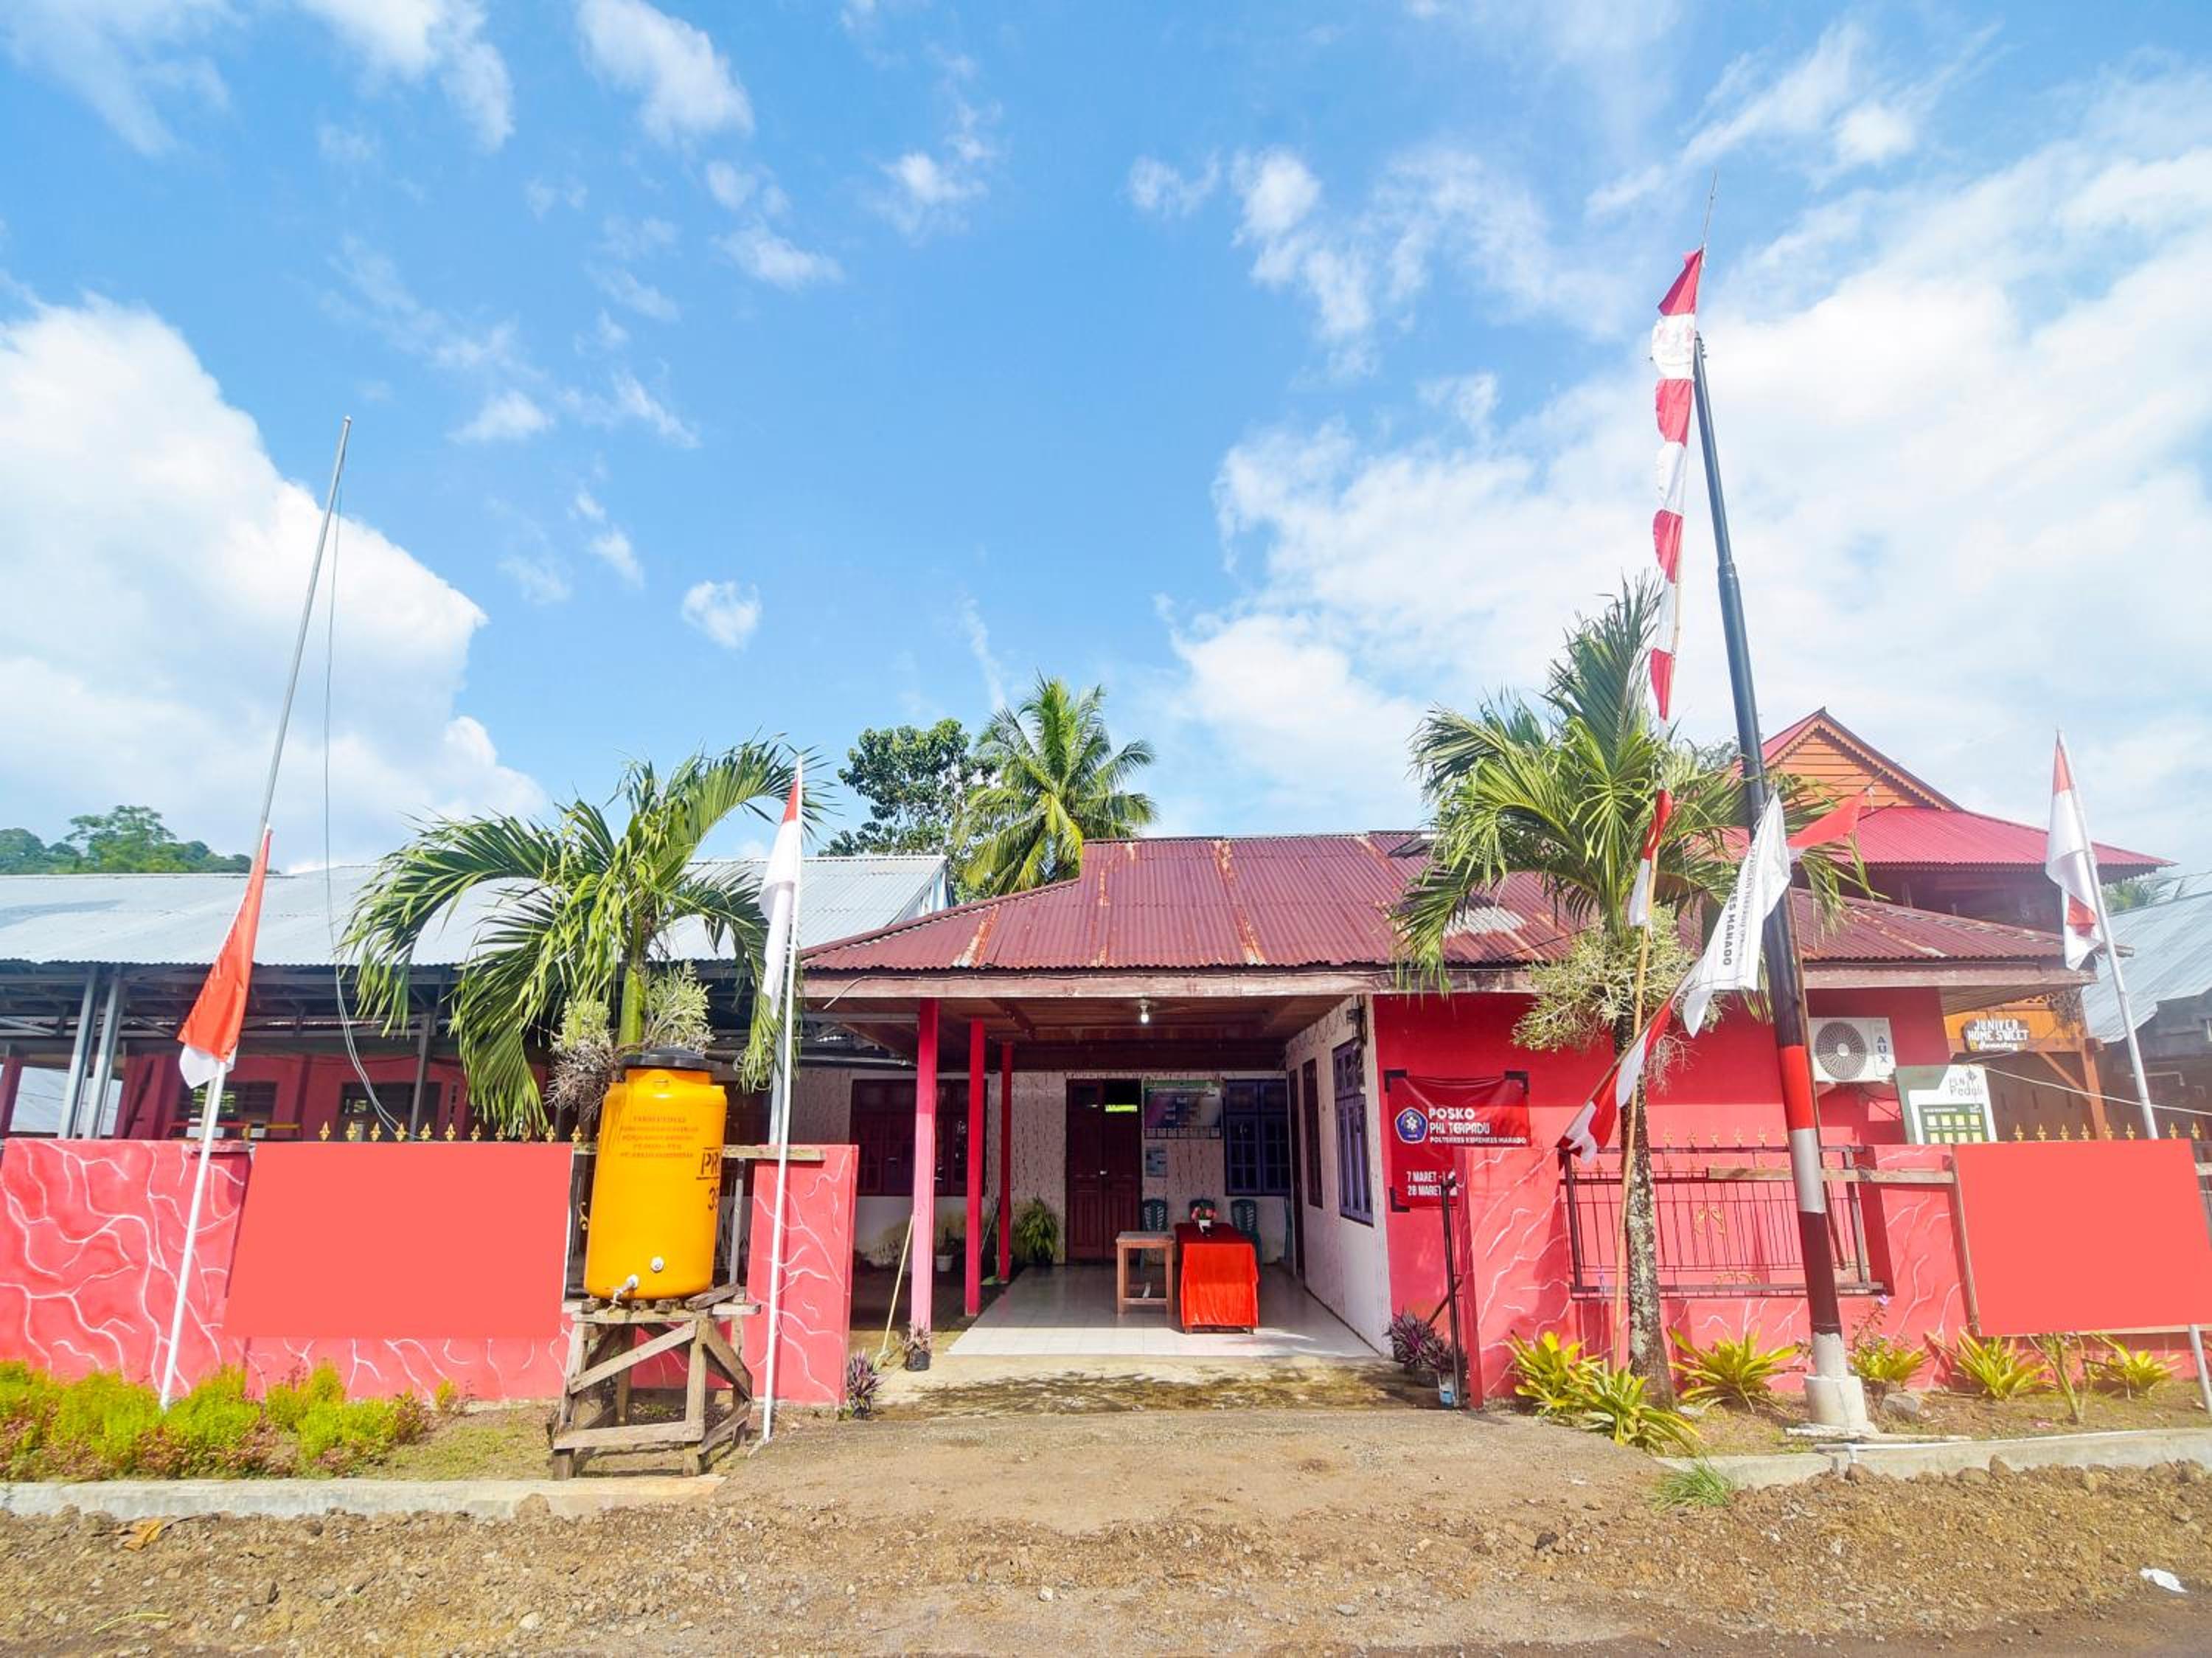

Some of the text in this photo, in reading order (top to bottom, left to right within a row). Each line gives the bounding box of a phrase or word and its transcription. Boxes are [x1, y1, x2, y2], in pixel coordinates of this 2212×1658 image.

[1722, 914, 1736, 965] MANADO
[1966, 1030, 2029, 1041] HOME SWEET
[1877, 1036, 1888, 1063] AUX
[1428, 1108, 1475, 1120] POSKO
[1448, 1122, 1490, 1134] TERPADU
[1413, 1170, 1437, 1183] MARET
